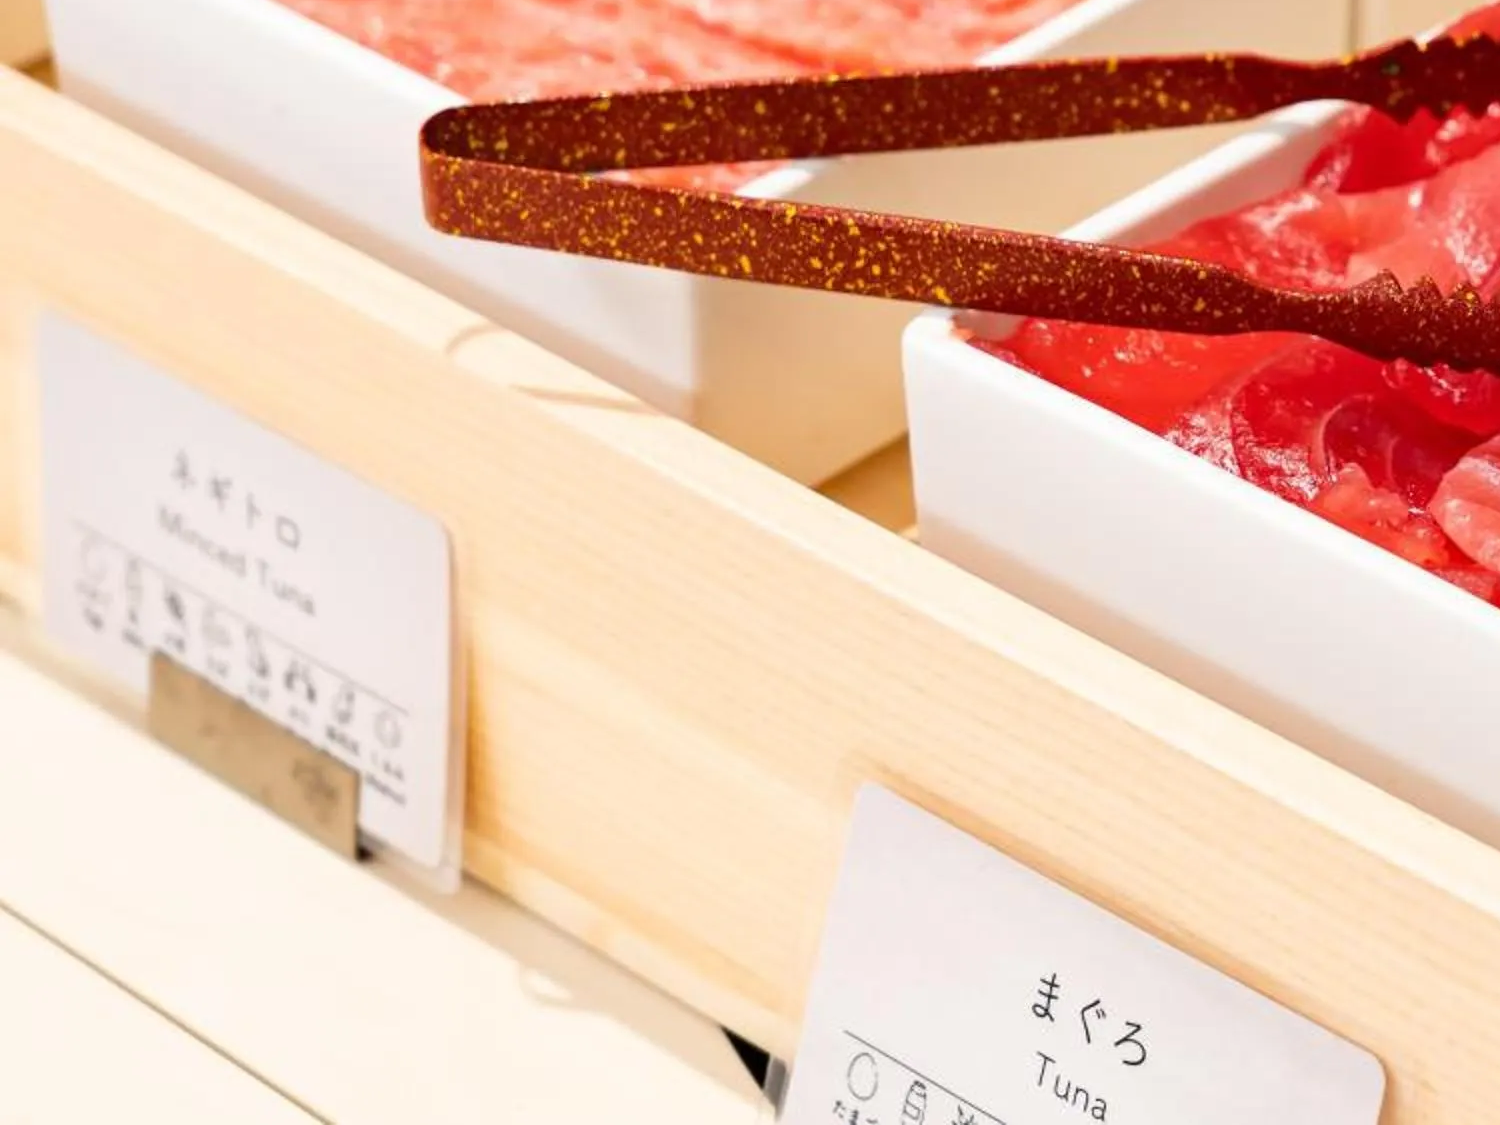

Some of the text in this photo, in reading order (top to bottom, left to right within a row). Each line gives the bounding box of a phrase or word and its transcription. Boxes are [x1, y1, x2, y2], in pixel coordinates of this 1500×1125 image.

[169, 448, 301, 552] ネギトロ
[158, 503, 315, 616] Minced Tuna
[1032, 973, 1147, 1066] まぐろ
[1036, 1051, 1108, 1122] Tuna
